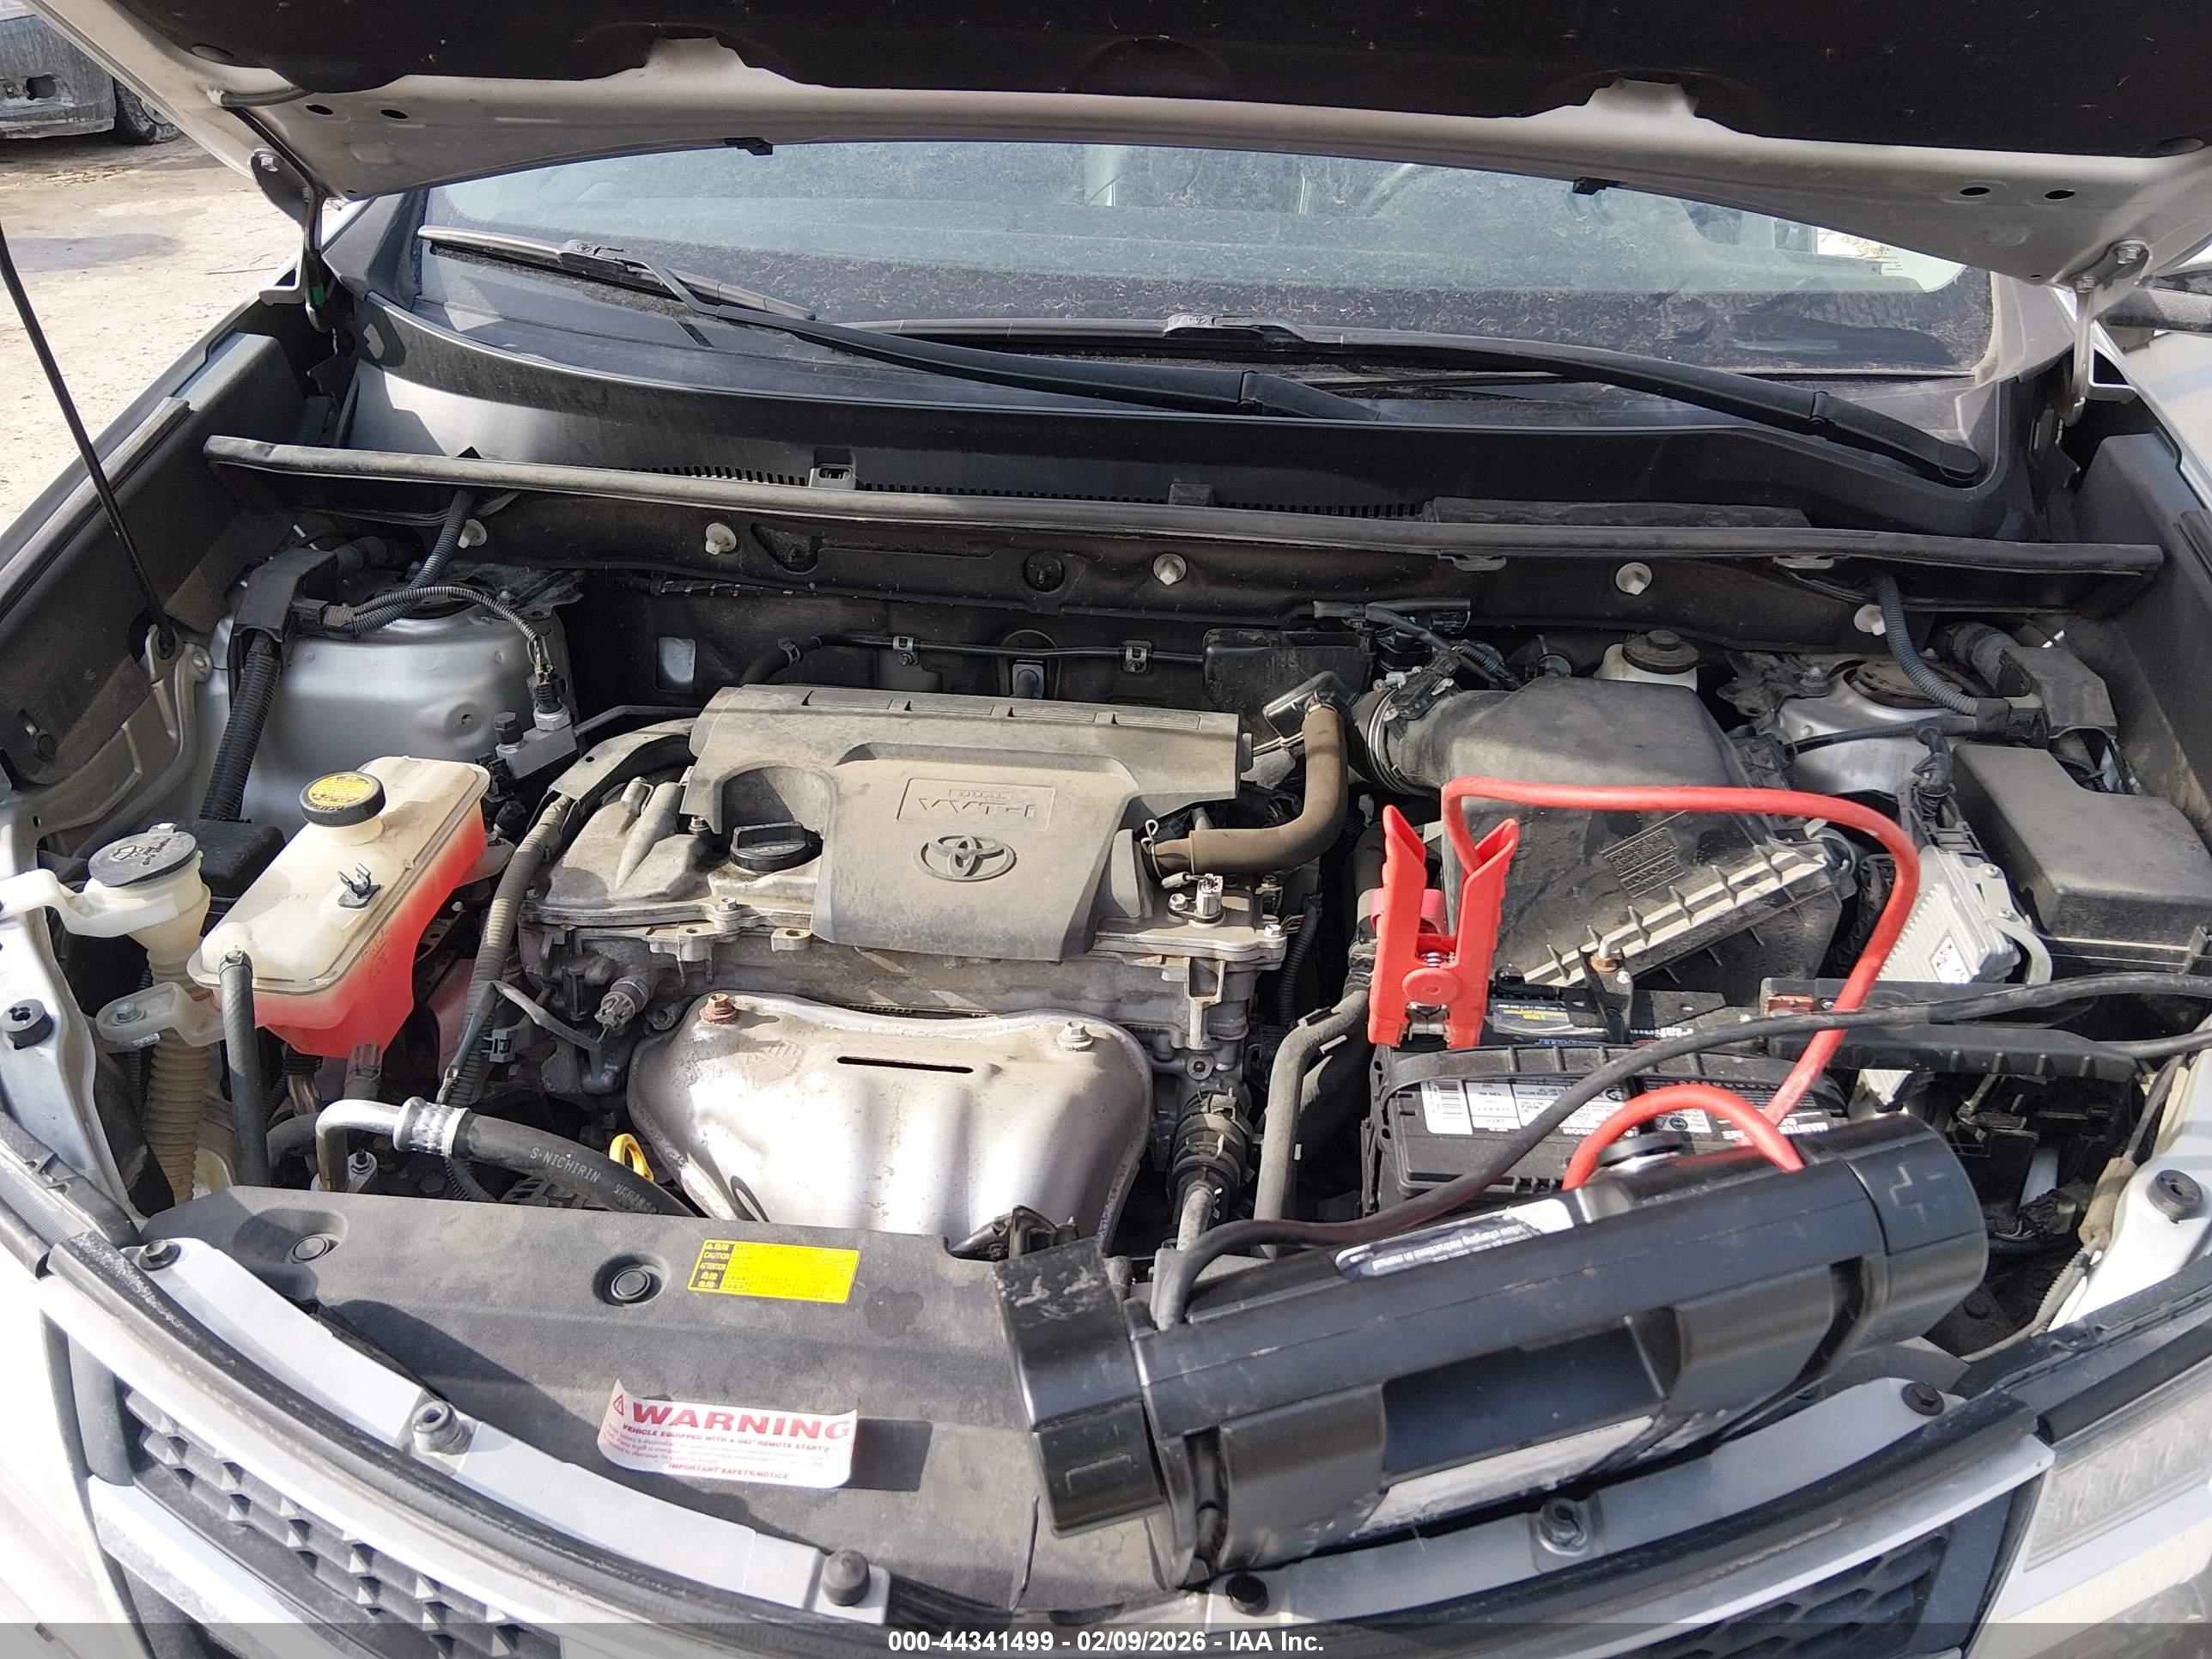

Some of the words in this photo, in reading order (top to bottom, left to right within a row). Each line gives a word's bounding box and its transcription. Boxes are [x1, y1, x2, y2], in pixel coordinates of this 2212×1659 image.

[1462, 1230, 1499, 1245] charging
[1413, 1239, 1463, 1258] instructions
[1372, 1255, 1404, 1271] manual
[633, 1401, 850, 1440] WARNING
[623, 1423, 658, 1437] VEHICLE
[659, 1430, 702, 1441] EQUIPPED
[757, 1440, 792, 1449] REMOTE
[668, 1462, 719, 1473] IMPORTANT
[757, 1471, 789, 1480] NOTICE
